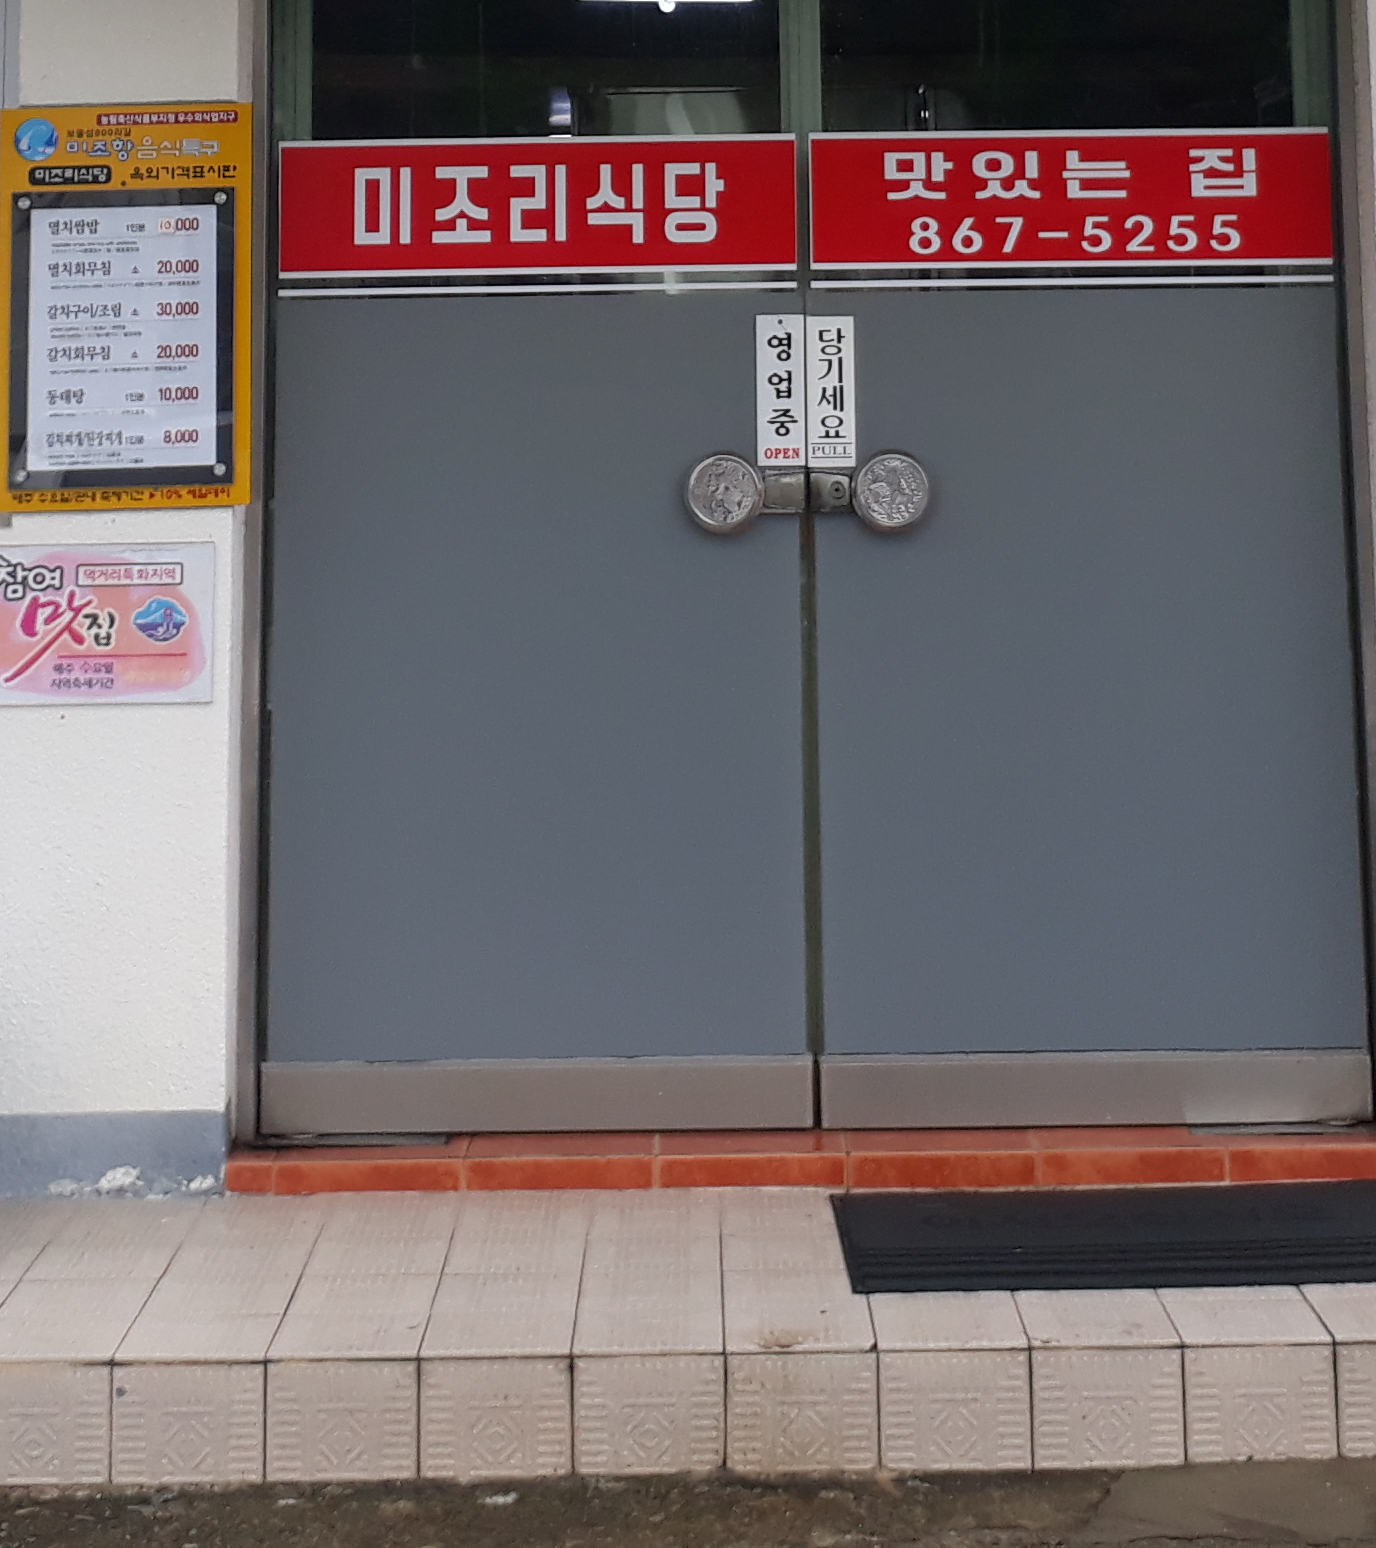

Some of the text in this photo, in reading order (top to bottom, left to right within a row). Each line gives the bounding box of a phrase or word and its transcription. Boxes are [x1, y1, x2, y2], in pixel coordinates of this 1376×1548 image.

[34, 168, 108, 183] 미조리식당
[883, 147, 1259, 202] 맛있는 집
[352, 161, 726, 247] 미조리식당
[48, 218, 100, 235] 멸치쌈밥
[907, 213, 1243, 255] 867-5255
[157, 259, 199, 275] 20,000
[156, 302, 199, 318] 30,000
[156, 344, 199, 360] 20,000
[767, 332, 799, 437] 영업중
[817, 327, 847, 439] 당기세요
[158, 386, 199, 402] 10,000
[162, 428, 199, 445] 8,000
[764, 447, 800, 459] OPEN
[811, 445, 852, 456] PULL
